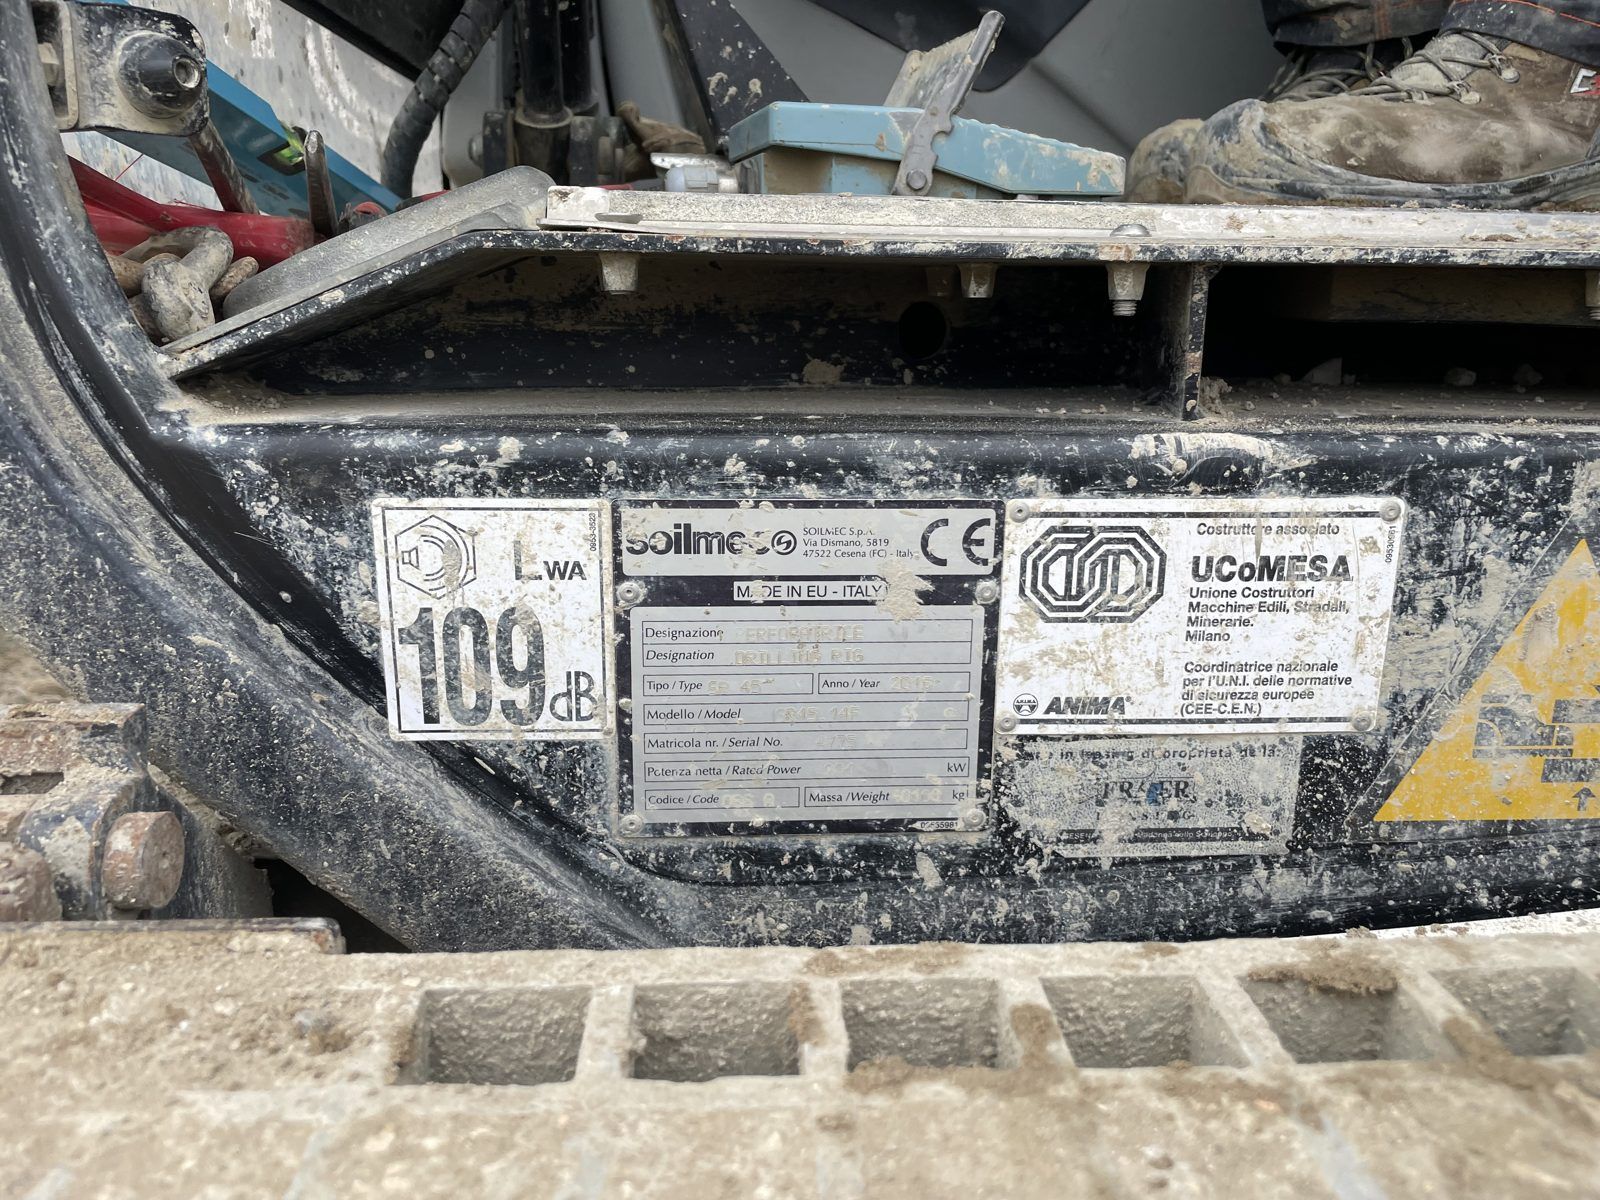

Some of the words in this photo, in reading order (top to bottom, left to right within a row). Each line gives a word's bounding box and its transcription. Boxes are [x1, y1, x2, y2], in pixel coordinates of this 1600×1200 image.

[802, 527, 847, 536] SOILMEC
[802, 538, 818, 547] Via
[820, 538, 864, 548] Dismano,
[866, 538, 890, 547] 5819
[802, 549, 831, 558] 47522
[834, 549, 867, 558] Cesena
[869, 549, 888, 560] (FC)
[896, 549, 914, 560] Italy
[1191, 554, 1351, 583] UCoMESA
[736, 585, 782, 598] MDE
[786, 585, 802, 598] IN
[807, 585, 828, 598] EU
[843, 585, 882, 598] ITALY
[1189, 587, 1238, 598] Unione
[1241, 586, 1315, 598] Costruttori
[1187, 601, 1254, 613] Macchine
[1257, 601, 1290, 614] Edili,
[1293, 601, 1350, 614] Stradali,
[1186, 615, 1254, 628] Minerarie.
[645, 627, 724, 640] Designazione
[1185, 630, 1231, 642] Milano
[645, 649, 715, 662] Designation
[398, 606, 546, 726] 109
[549, 670, 599, 722] dB
[1184, 661, 1273, 673] Coordinatrice
[1276, 660, 1339, 672] nazionale
[647, 680, 670, 693] Tipo
[679, 680, 703, 693] Type
[822, 679, 849, 689] Anno
[859, 679, 881, 689] Year
[1182, 676, 1205, 689] per
[1252, 675, 1284, 686] delle
[1287, 674, 1353, 686] normative
[1181, 689, 1194, 701] di
[1197, 689, 1259, 701] sicurezza
[1262, 689, 1315, 702] europee
[646, 708, 695, 720] Modello
[704, 707, 742, 720] Model
[646, 736, 701, 748] Matricola
[705, 738, 719, 748] nr.
[728, 736, 760, 747] Serial
[763, 736, 784, 748] No.
[647, 766, 692, 777] Potenza
[695, 766, 722, 776] netta
[766, 765, 802, 775] Power
[947, 762, 967, 773] kW
[648, 794, 684, 805] Codice
[692, 794, 720, 805] Code
[809, 792, 843, 802] Massa
[952, 789, 965, 801] kg
